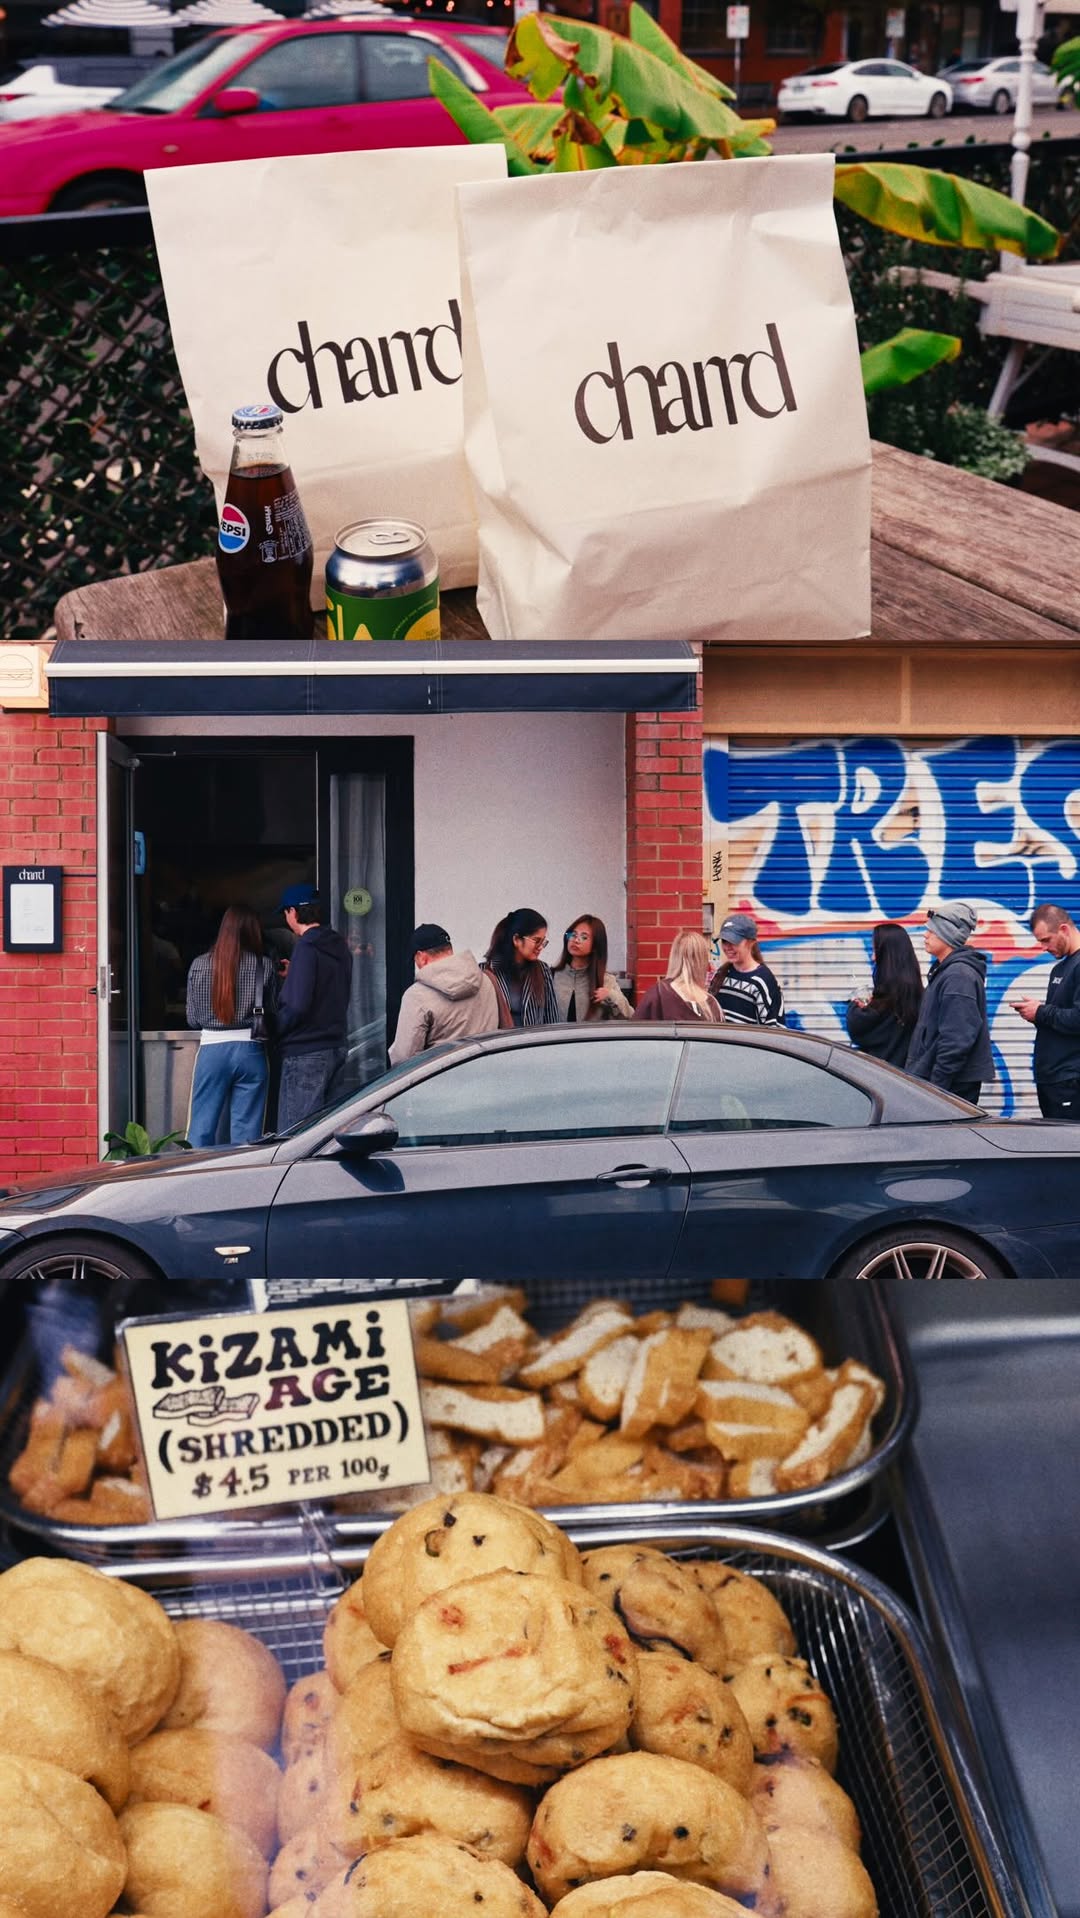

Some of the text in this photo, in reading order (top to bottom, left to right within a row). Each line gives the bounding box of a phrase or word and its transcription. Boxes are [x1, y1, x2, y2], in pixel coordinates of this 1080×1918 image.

[575, 323, 797, 444] charrd
[221, 521, 246, 536] EPSI
[264, 1364, 390, 1410] AGE
[158, 1401, 409, 1473] (SHREDDED)
[192, 1456, 390, 1498] $4.5 PER 100g
